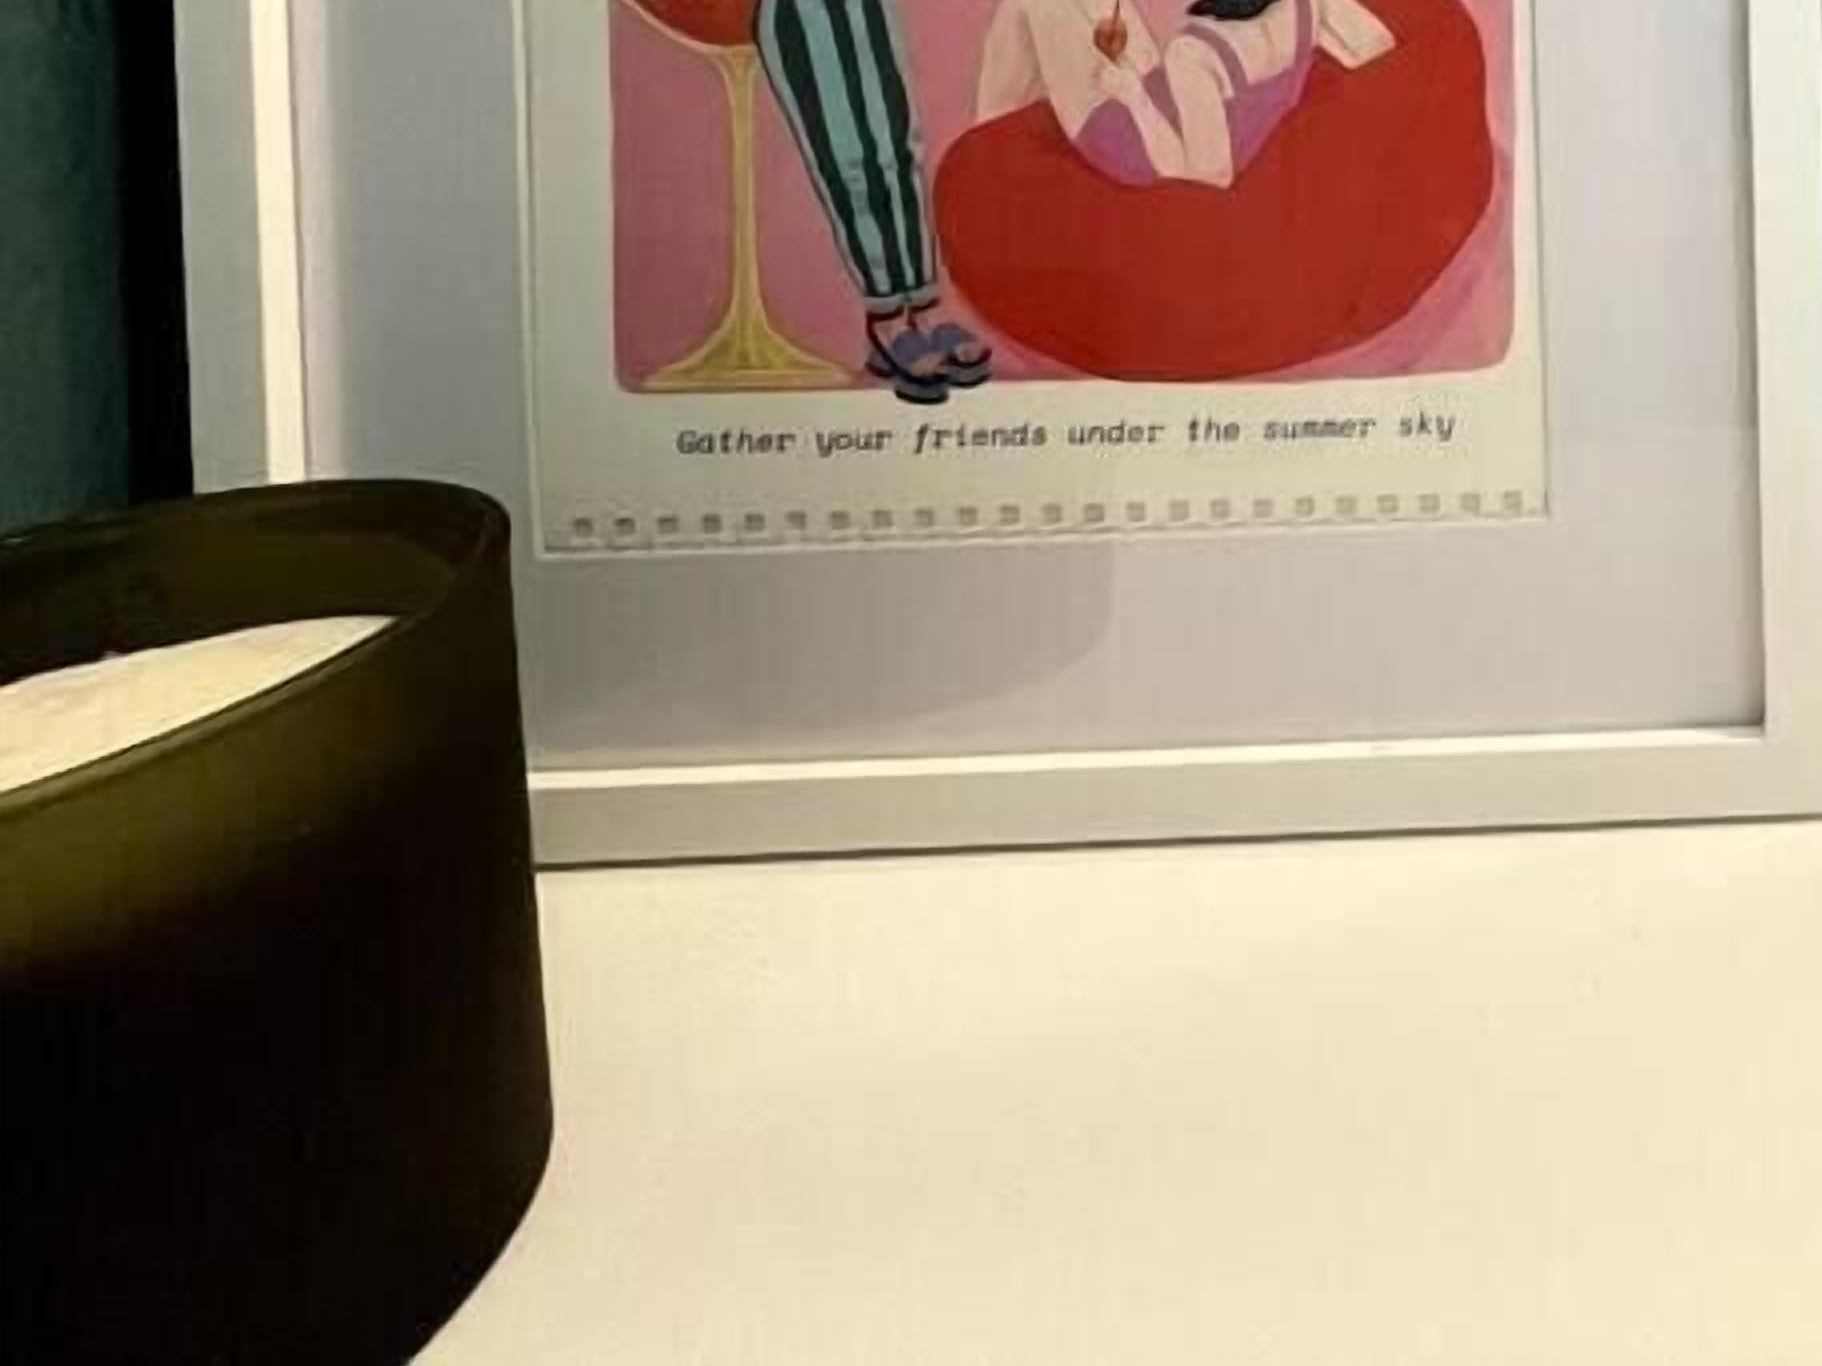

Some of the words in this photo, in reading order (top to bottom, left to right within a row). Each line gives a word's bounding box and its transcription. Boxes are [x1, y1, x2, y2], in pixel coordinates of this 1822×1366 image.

[675, 426, 796, 455] Gather
[816, 428, 892, 457] your
[913, 422, 1049, 455] friends
[1067, 418, 1165, 446] under
[1187, 412, 1241, 442] the
[1263, 417, 1376, 441] summer
[1398, 410, 1458, 443] sky
